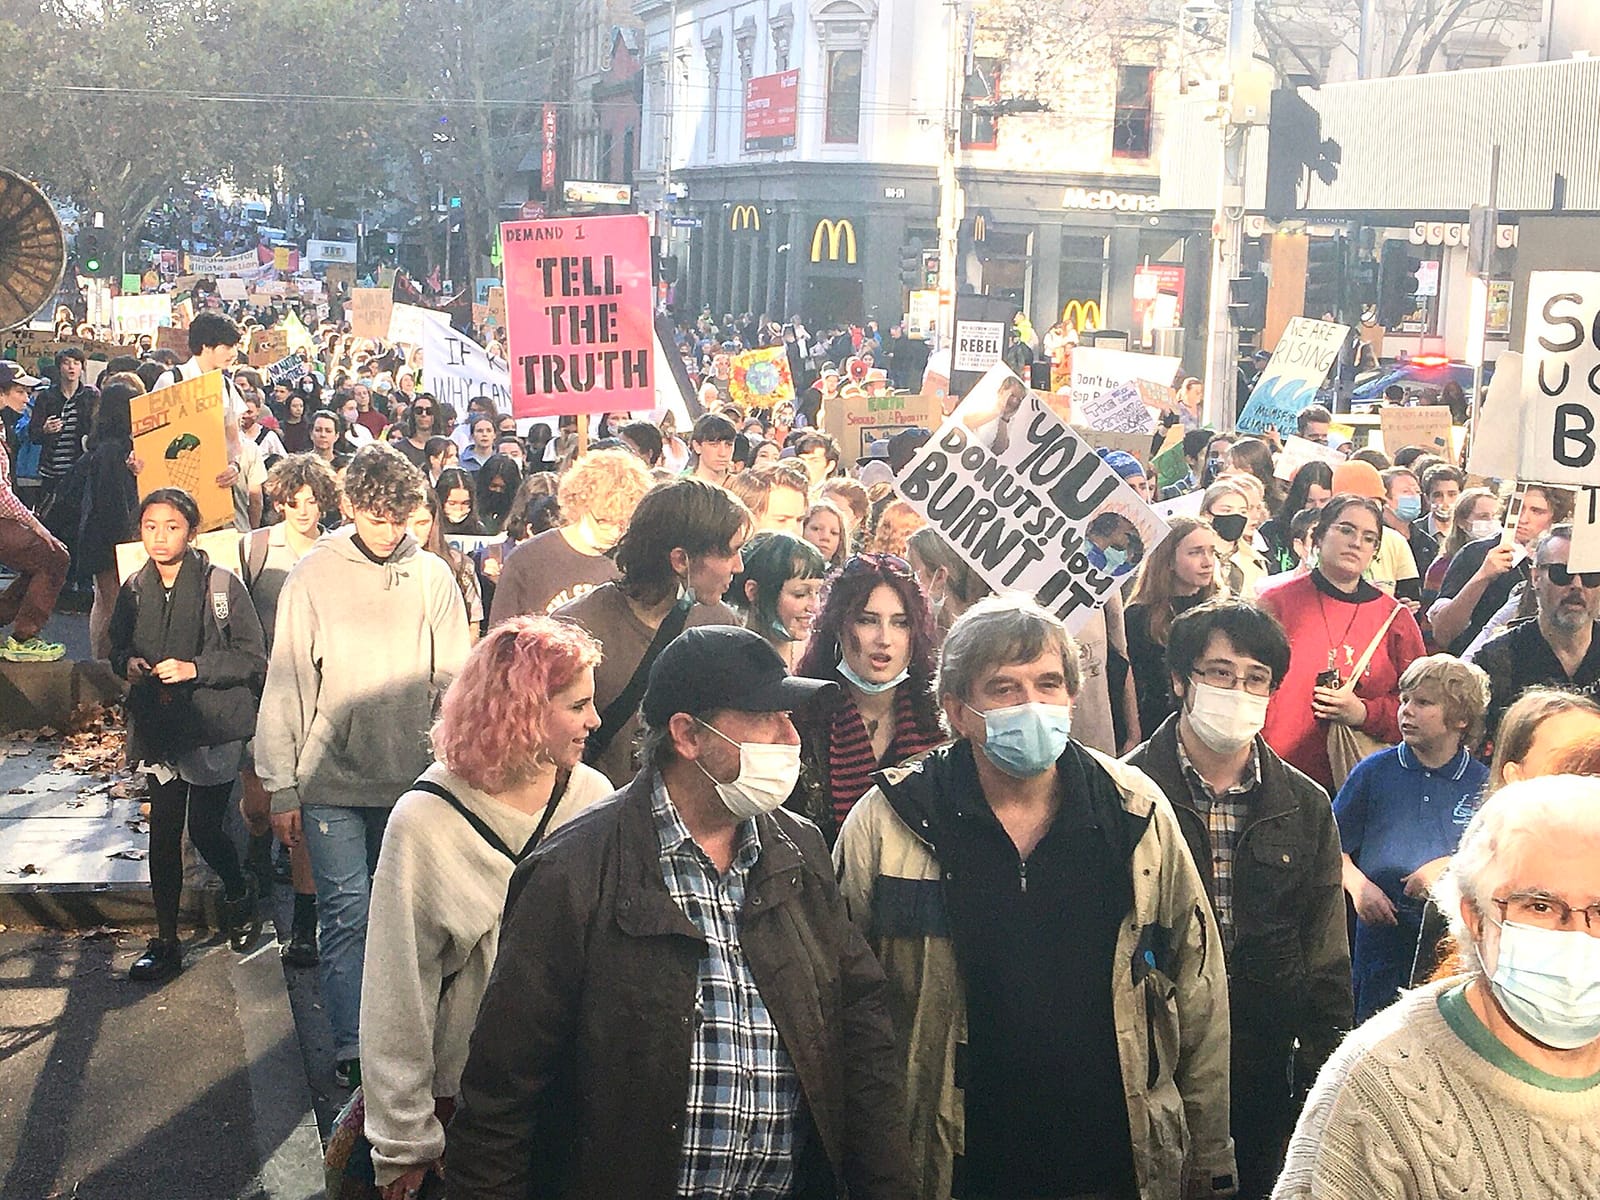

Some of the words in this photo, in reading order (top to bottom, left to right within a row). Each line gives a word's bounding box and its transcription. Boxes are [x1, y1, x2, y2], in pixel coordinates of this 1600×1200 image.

[506, 226, 564, 242] DEMAND
[575, 224, 586, 240] 1
[536, 255, 622, 297] TELL
[545, 303, 618, 345] THE
[1291, 319, 1310, 338] WE
[1310, 322, 1337, 341] ARE
[1538, 292, 1600, 353] S
[444, 338, 471, 366] IF
[960, 338, 998, 354] REBEL
[1272, 339, 1335, 372] RISING
[518, 349, 648, 396] TRUTH
[1106, 377, 1120, 390] be
[149, 376, 206, 414] EARTH
[433, 376, 473, 409] WHY
[179, 404, 189, 419] A
[939, 426, 1067, 548] DONUTS!
[899, 451, 1045, 588] BURNT
